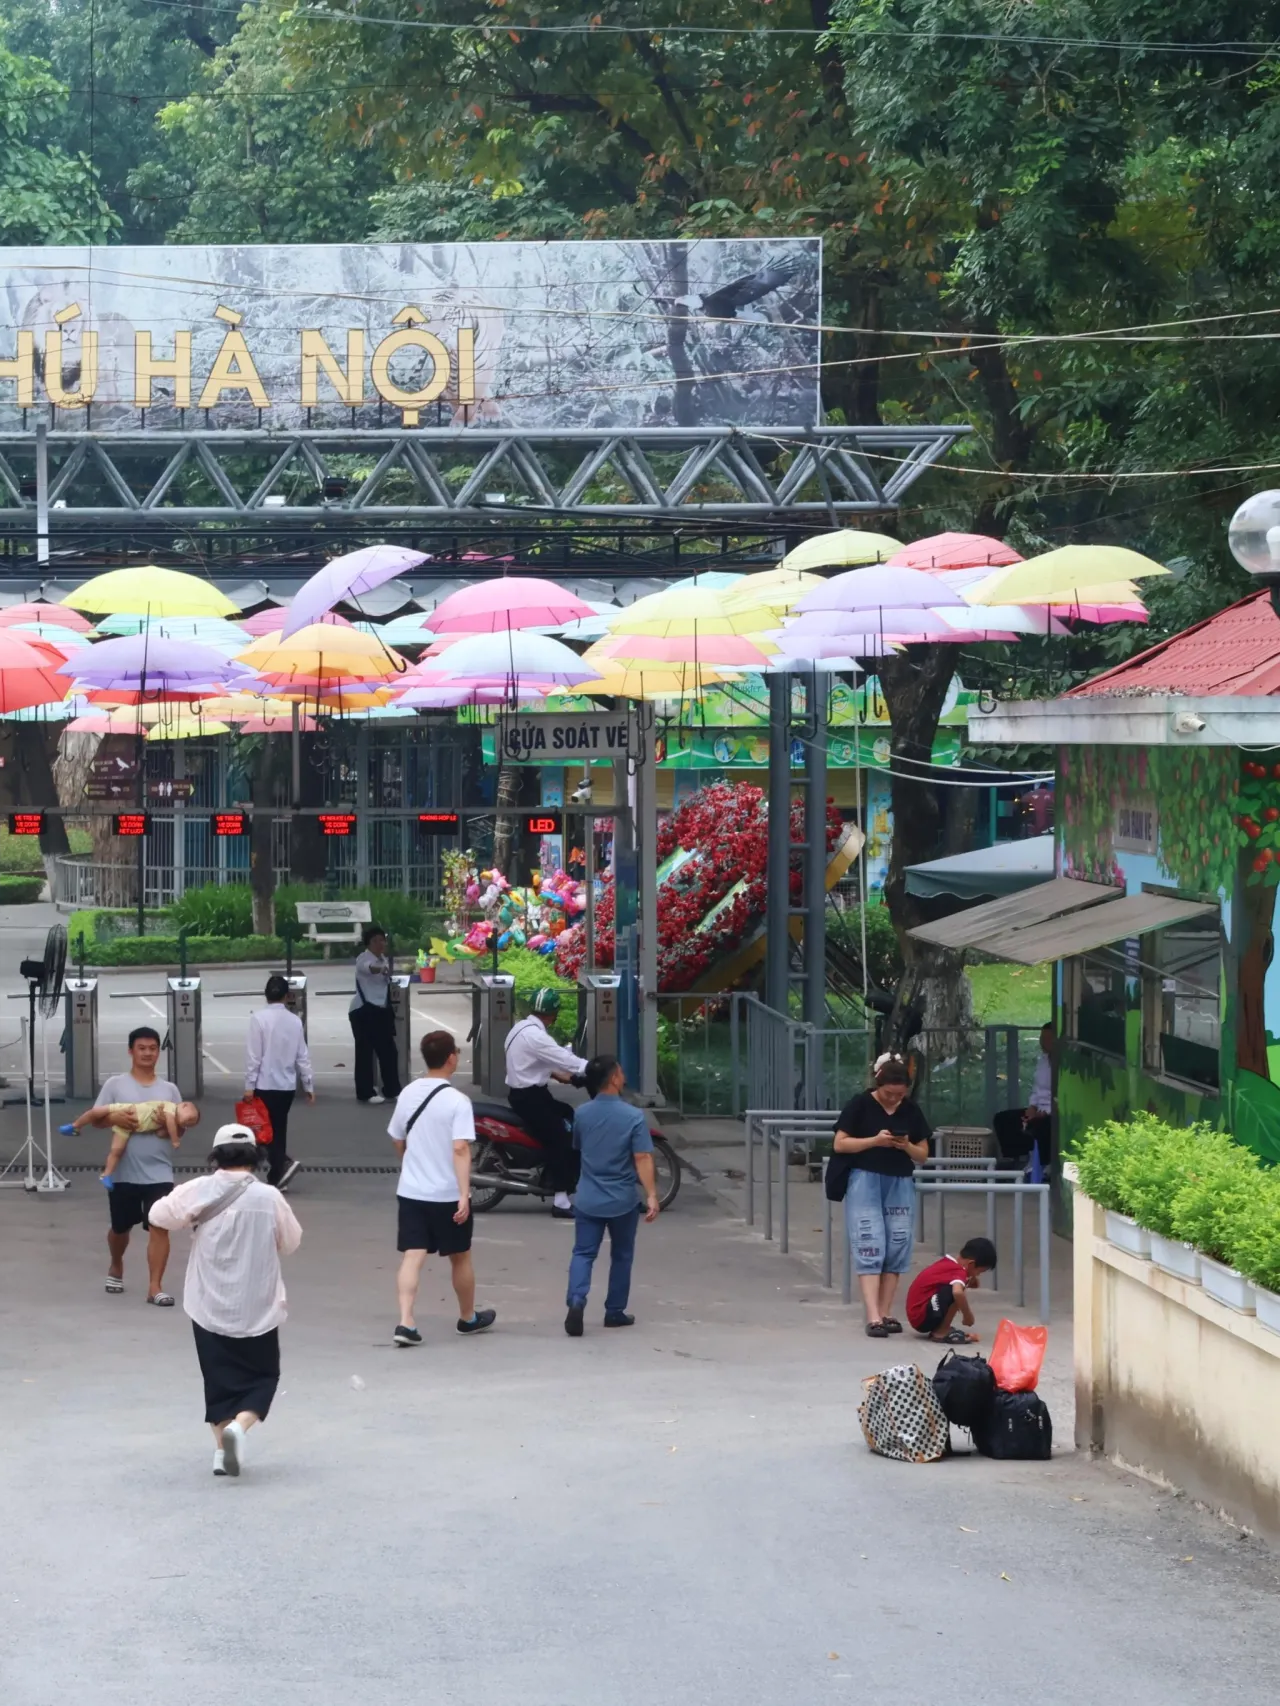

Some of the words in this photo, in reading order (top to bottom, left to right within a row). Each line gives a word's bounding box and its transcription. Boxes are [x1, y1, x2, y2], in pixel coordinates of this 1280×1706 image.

[135, 305, 272, 409] HÀ
[301, 306, 475, 426] NỘI
[552, 722, 600, 749] SOÁT
[605, 721, 628, 748] VÉ
[529, 819, 555, 833] LED
[884, 1206, 910, 1216] LUCKY
[858, 1247, 880, 1257] STAR
